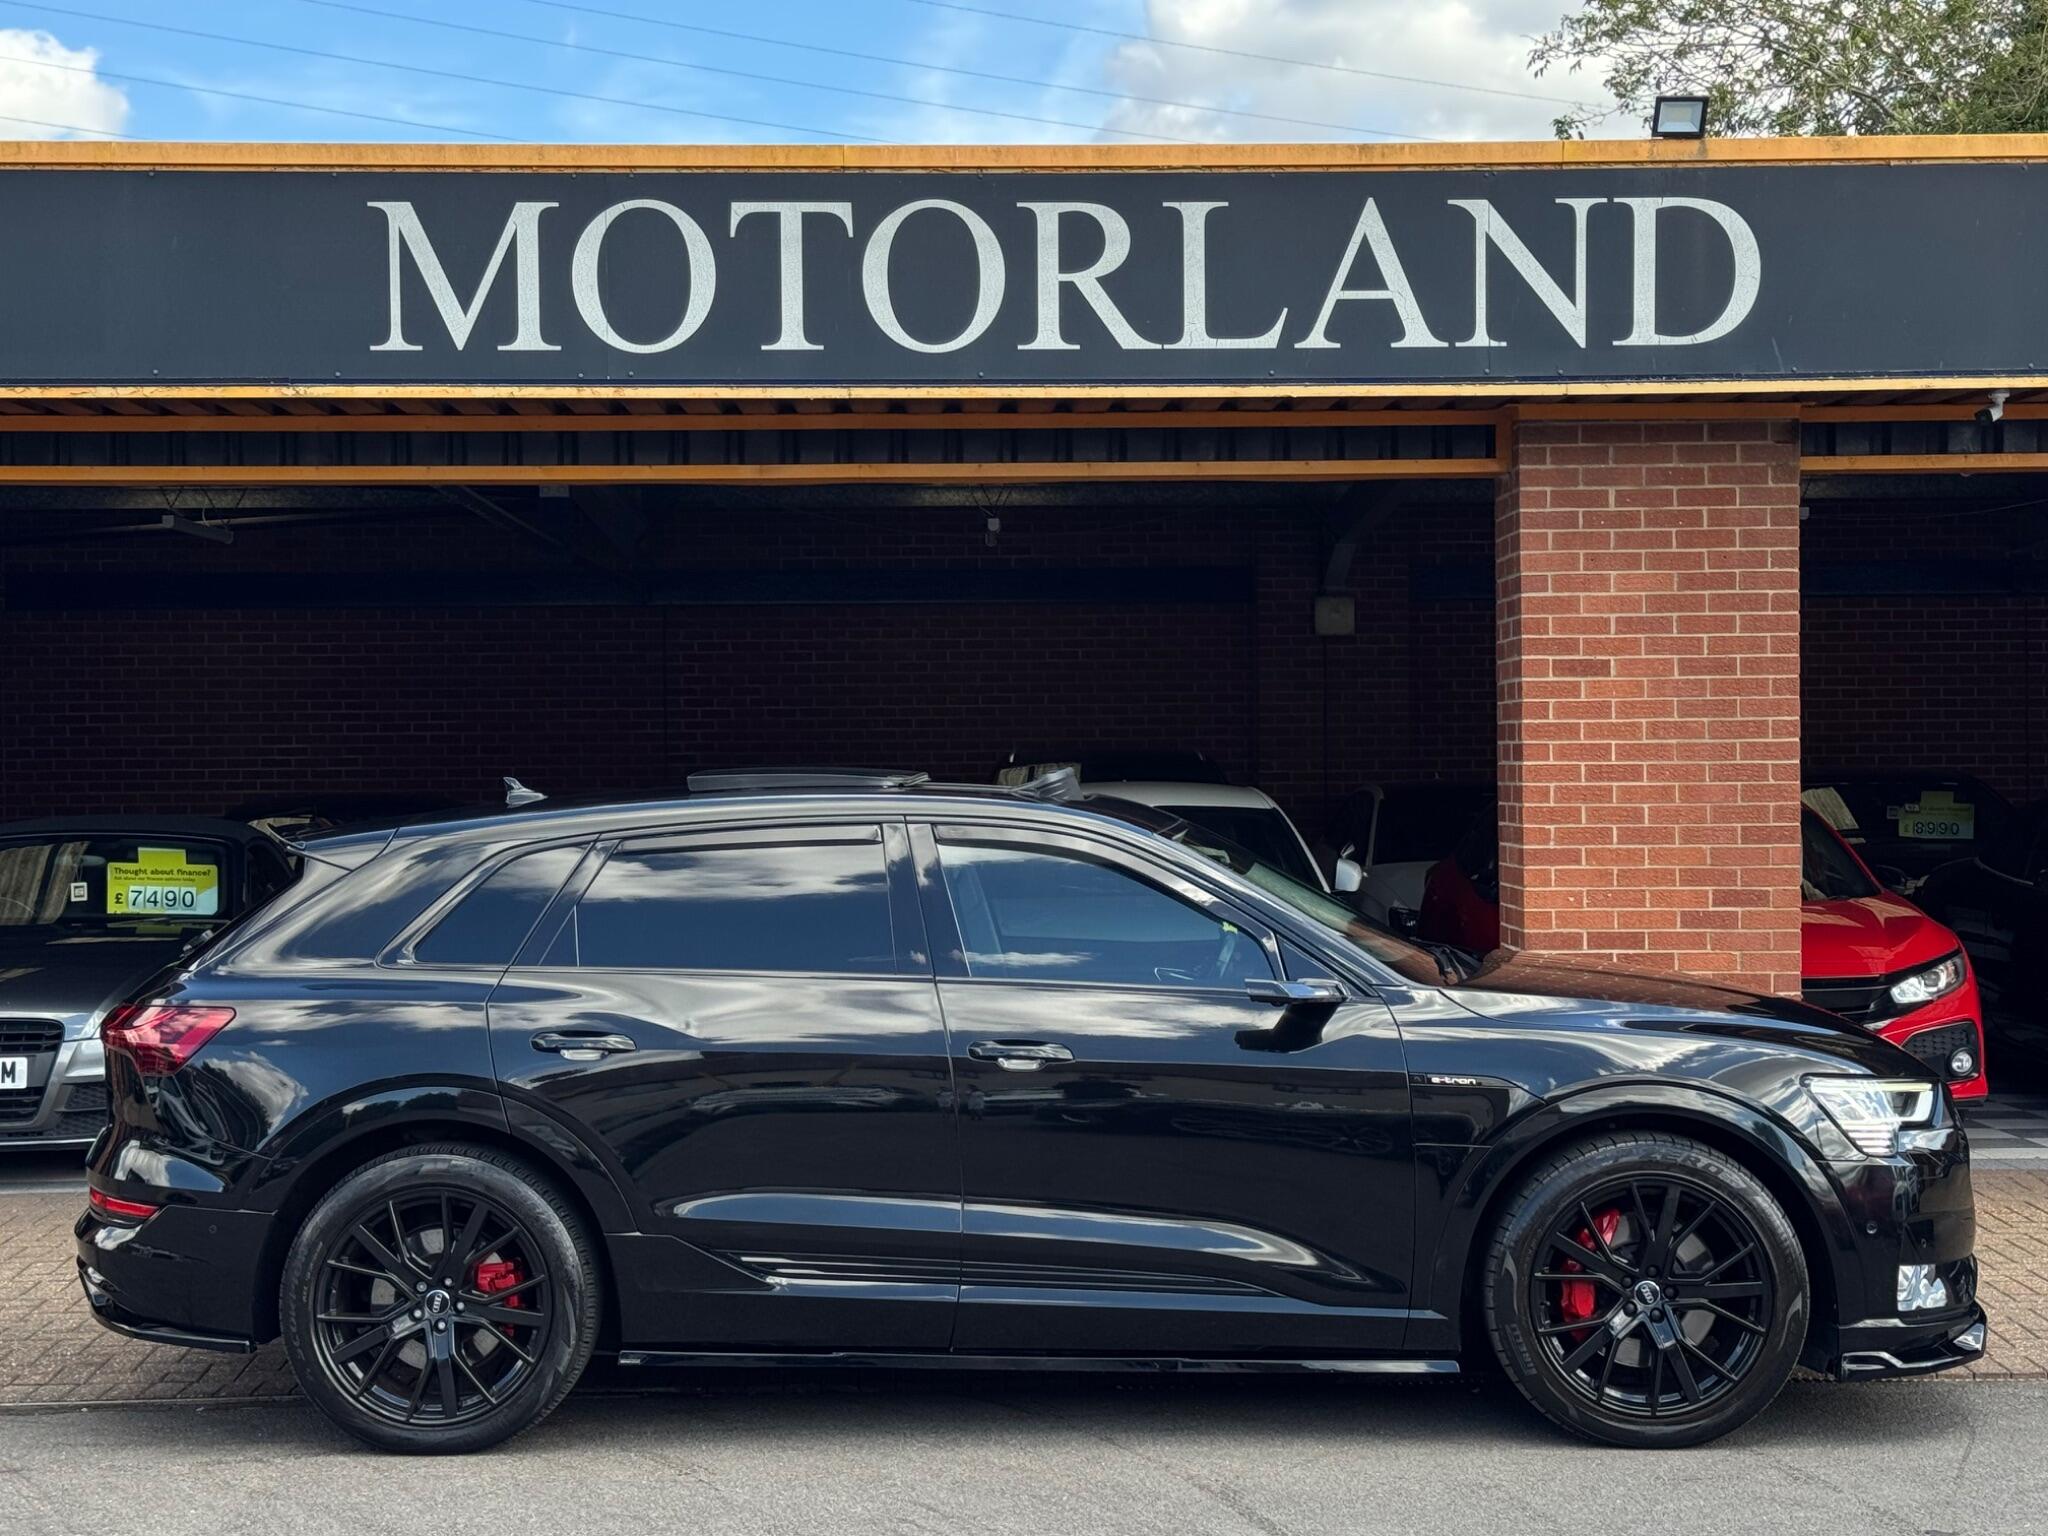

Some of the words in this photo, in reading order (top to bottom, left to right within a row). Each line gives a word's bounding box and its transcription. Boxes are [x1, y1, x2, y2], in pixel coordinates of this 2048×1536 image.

[367, 197, 1762, 354] MOTORLAND
[1915, 821, 1960, 835] 8990
[114, 867, 148, 876] Thought
[176, 869, 211, 877] finance?
[114, 892, 123, 904] £
[130, 890, 194, 907] 7490
[1, 1061, 16, 1083] M
[1431, 1076, 1476, 1085] e-tron
